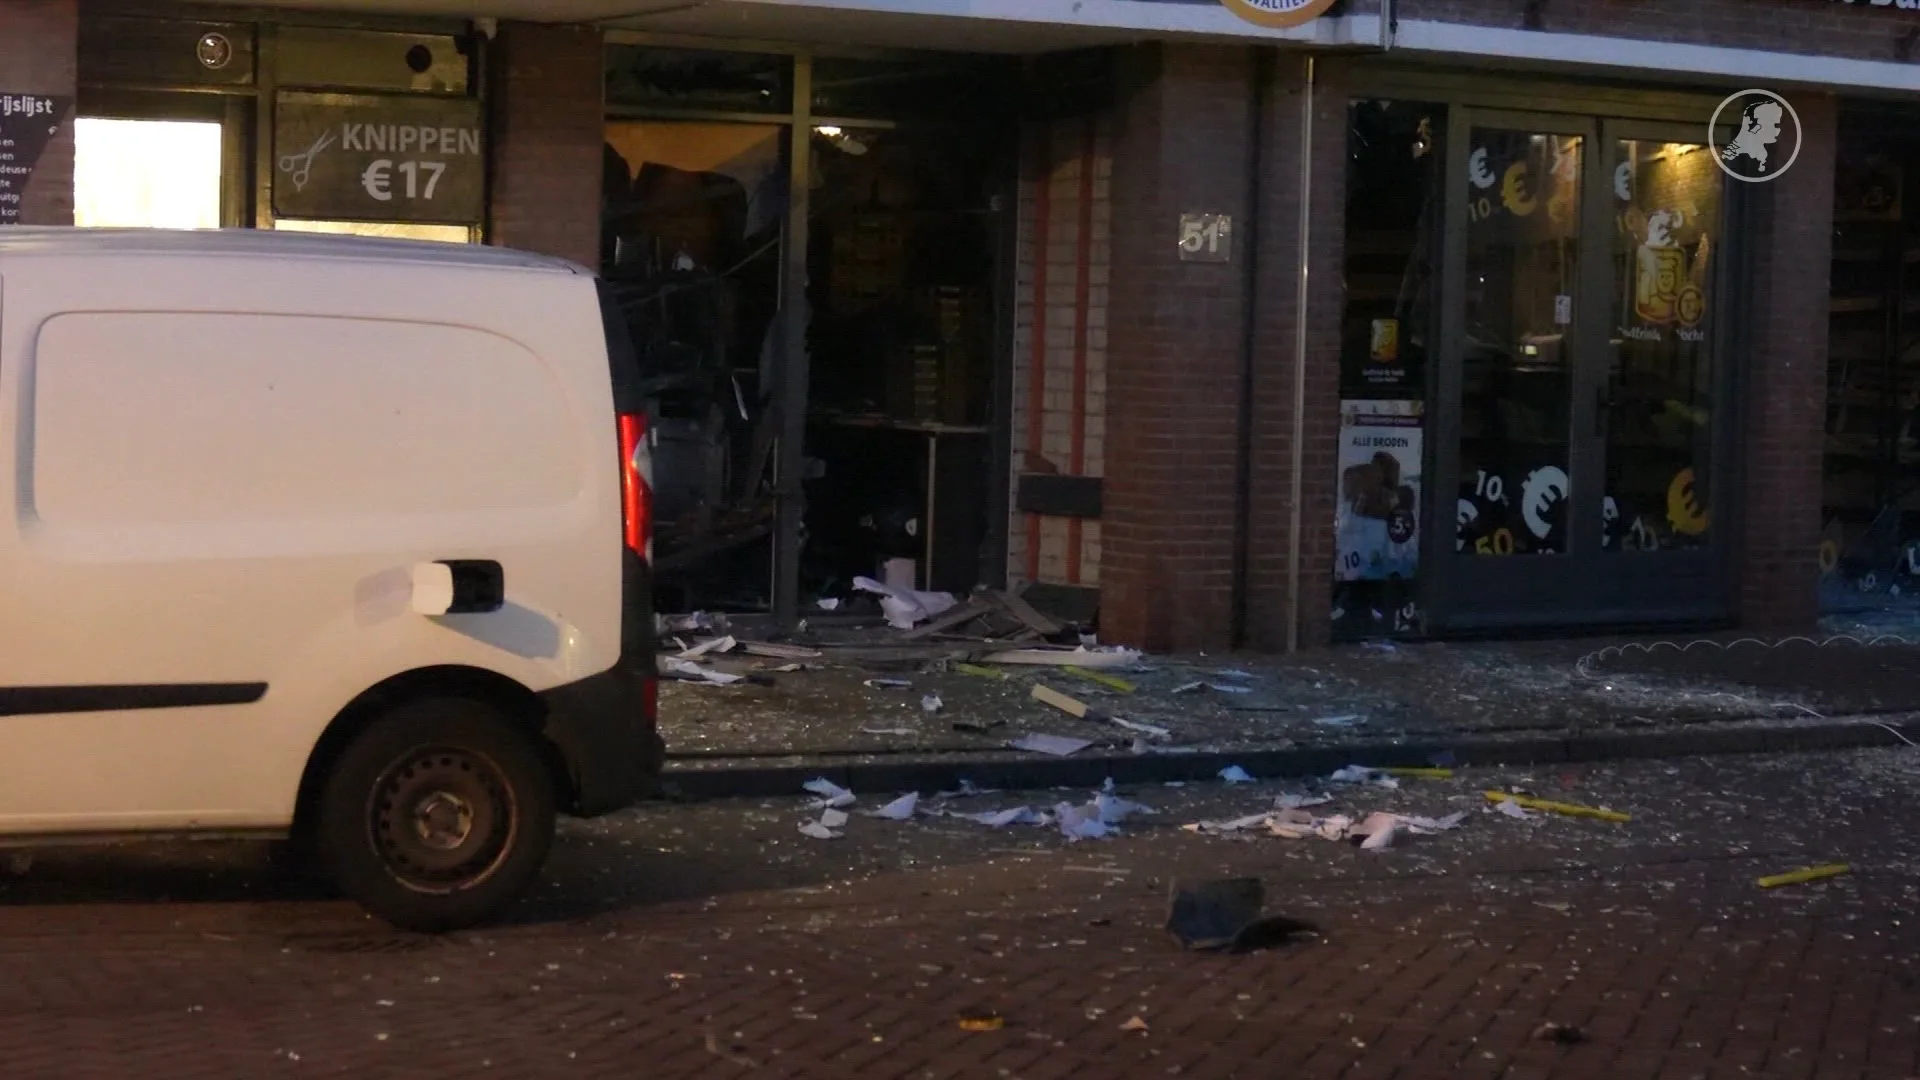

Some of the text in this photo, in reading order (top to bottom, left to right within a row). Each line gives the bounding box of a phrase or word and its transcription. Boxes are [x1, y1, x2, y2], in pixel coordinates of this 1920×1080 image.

[342, 123, 480, 155] KNIPPEN
[1182, 221, 1219, 253] 51
[1352, 436, 1409, 447] ALLE BRODEN
[1475, 469, 1503, 502] 10
